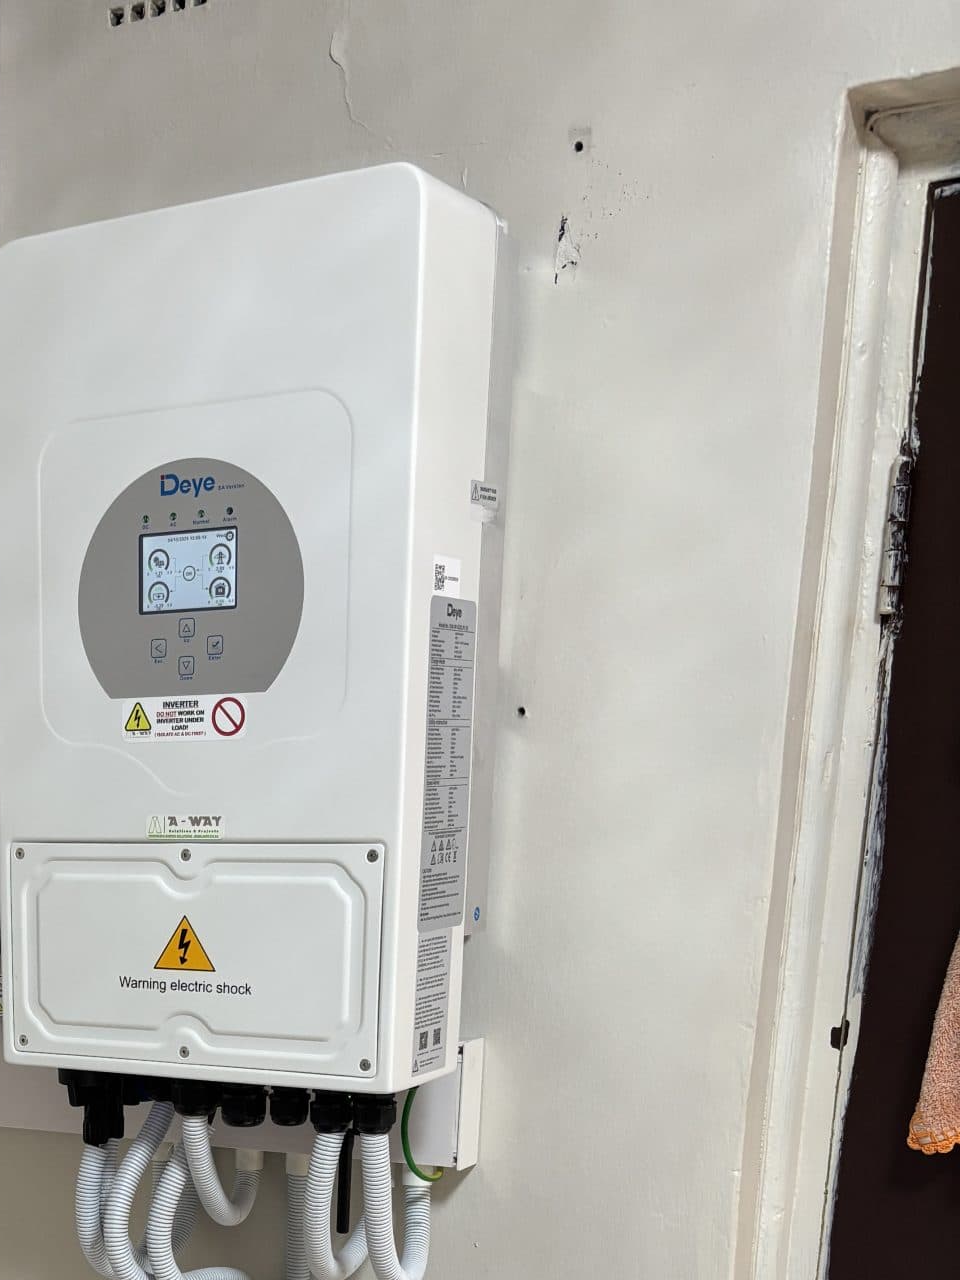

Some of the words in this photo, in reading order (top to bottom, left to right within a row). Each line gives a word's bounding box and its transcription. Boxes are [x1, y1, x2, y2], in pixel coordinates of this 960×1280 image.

[160, 473, 216, 498] Deye
[446, 603, 463, 621] Deye
[162, 700, 199, 710] INVERTER
[156, 711, 165, 719] DO
[119, 975, 167, 993] Warning
[170, 979, 213, 993] electric
[216, 981, 252, 995] shock
